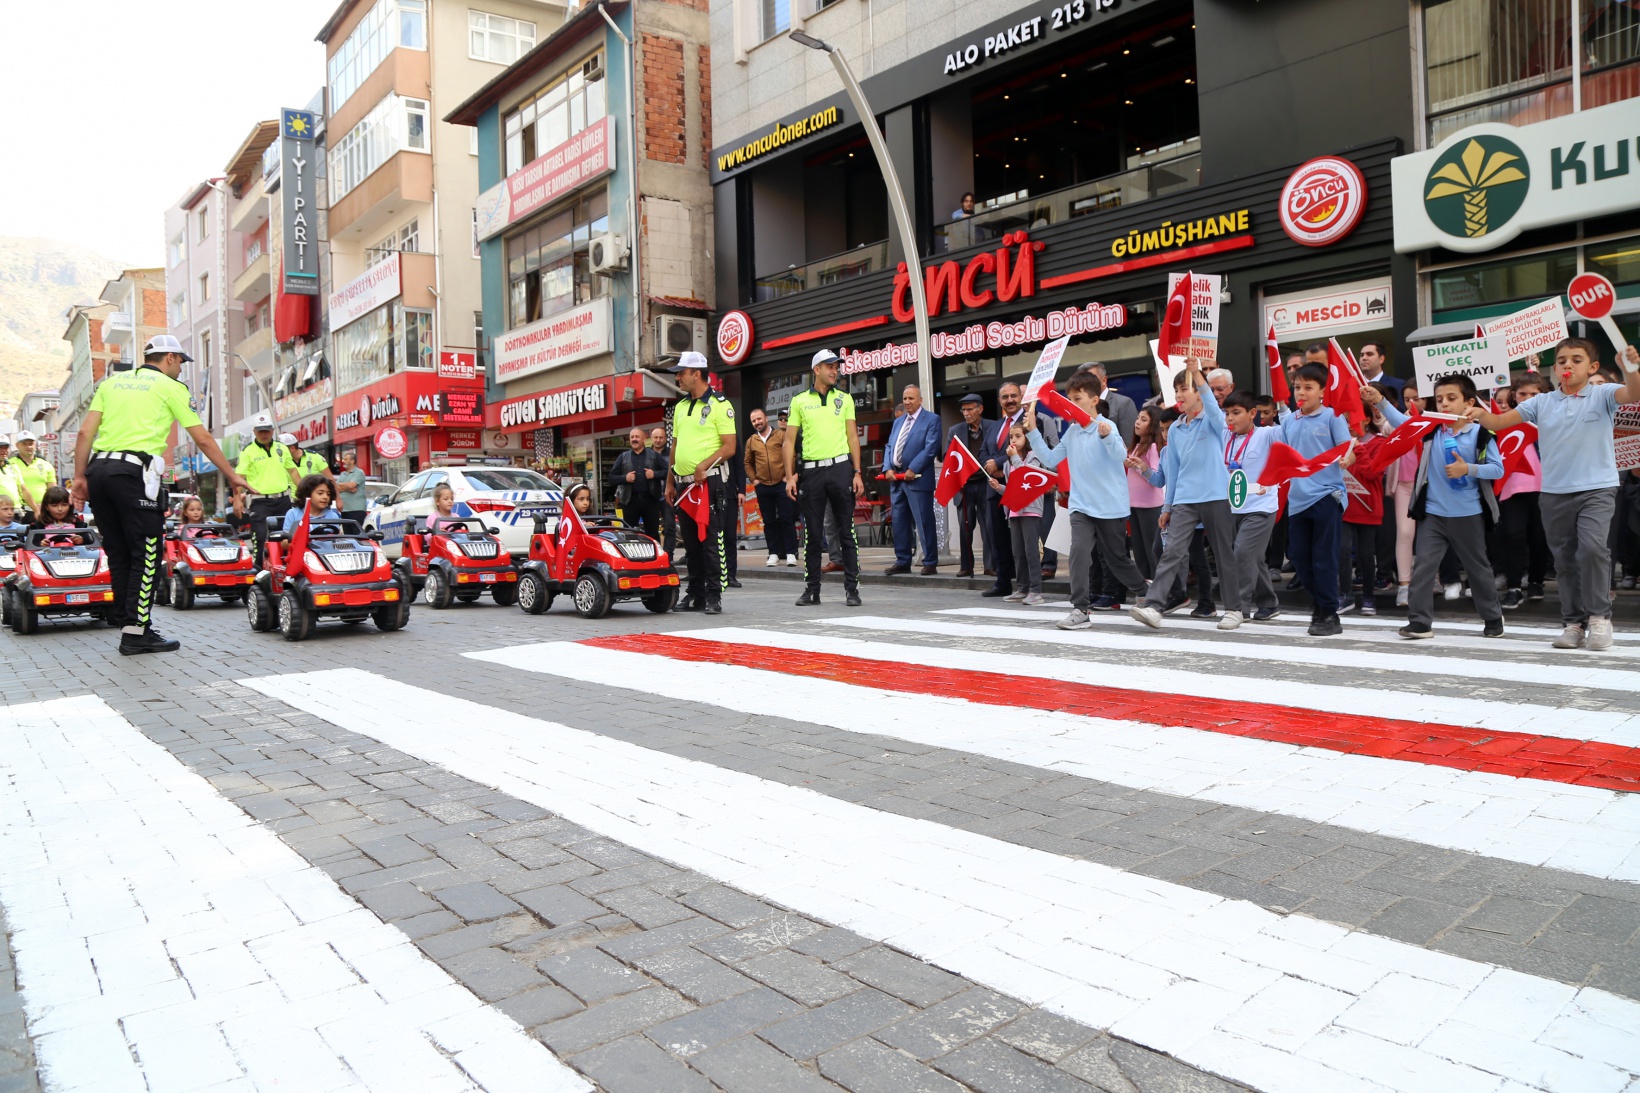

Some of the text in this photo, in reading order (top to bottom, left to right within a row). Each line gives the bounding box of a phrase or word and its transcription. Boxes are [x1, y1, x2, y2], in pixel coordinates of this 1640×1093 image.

[944, 44, 978, 74] ALO
[984, 16, 1042, 57] PAKET
[1051, 0, 1085, 30] 213
[582, 123, 604, 153] KÖYLERİ
[718, 106, 837, 171] www.oncudoner.com
[292, 141, 306, 193] İYİ
[1551, 136, 1640, 190] Ku
[294, 198, 307, 271] PARTİ
[1111, 209, 1249, 258] GÜMÜŞHANE
[1571, 283, 1610, 309] DUR
[1296, 300, 1361, 324] MESCİD
[1489, 303, 1556, 333] ELİMİZDE BAYRAKLARLA
[1505, 317, 1543, 336] 29 EYLÜL'DE
[505, 311, 593, 353] DÖRTKONAKLILAR YARDIMLAŞMA
[839, 302, 1126, 375] İskenderu Usulü Soslu Dürüm
[1507, 330, 1564, 357] LUŞUYORUZ.
[1511, 320, 1560, 344] GEÇİTLERİNDE
[450, 353, 465, 366] 1.
[499, 357, 528, 376] DAYANIŞMA
[529, 354, 535, 366] VE
[537, 345, 556, 363] KÜLTÜR
[557, 335, 582, 358] DERNEĞİ
[1427, 338, 1488, 357] DİKKATLİ
[1445, 355, 1472, 366] GEÇ
[441, 364, 473, 373] NOTER
[336, 409, 359, 430] MERKEZ
[372, 393, 399, 420] DÜRÜM
[447, 393, 476, 402] MERKEZİ
[501, 383, 605, 427] GÜVEN ŞARKÜTERİ
[443, 414, 481, 422] SİSTEMLERİ
[451, 439, 475, 447] DÜRÜM
[1234, 474, 1242, 505] GEÇ
